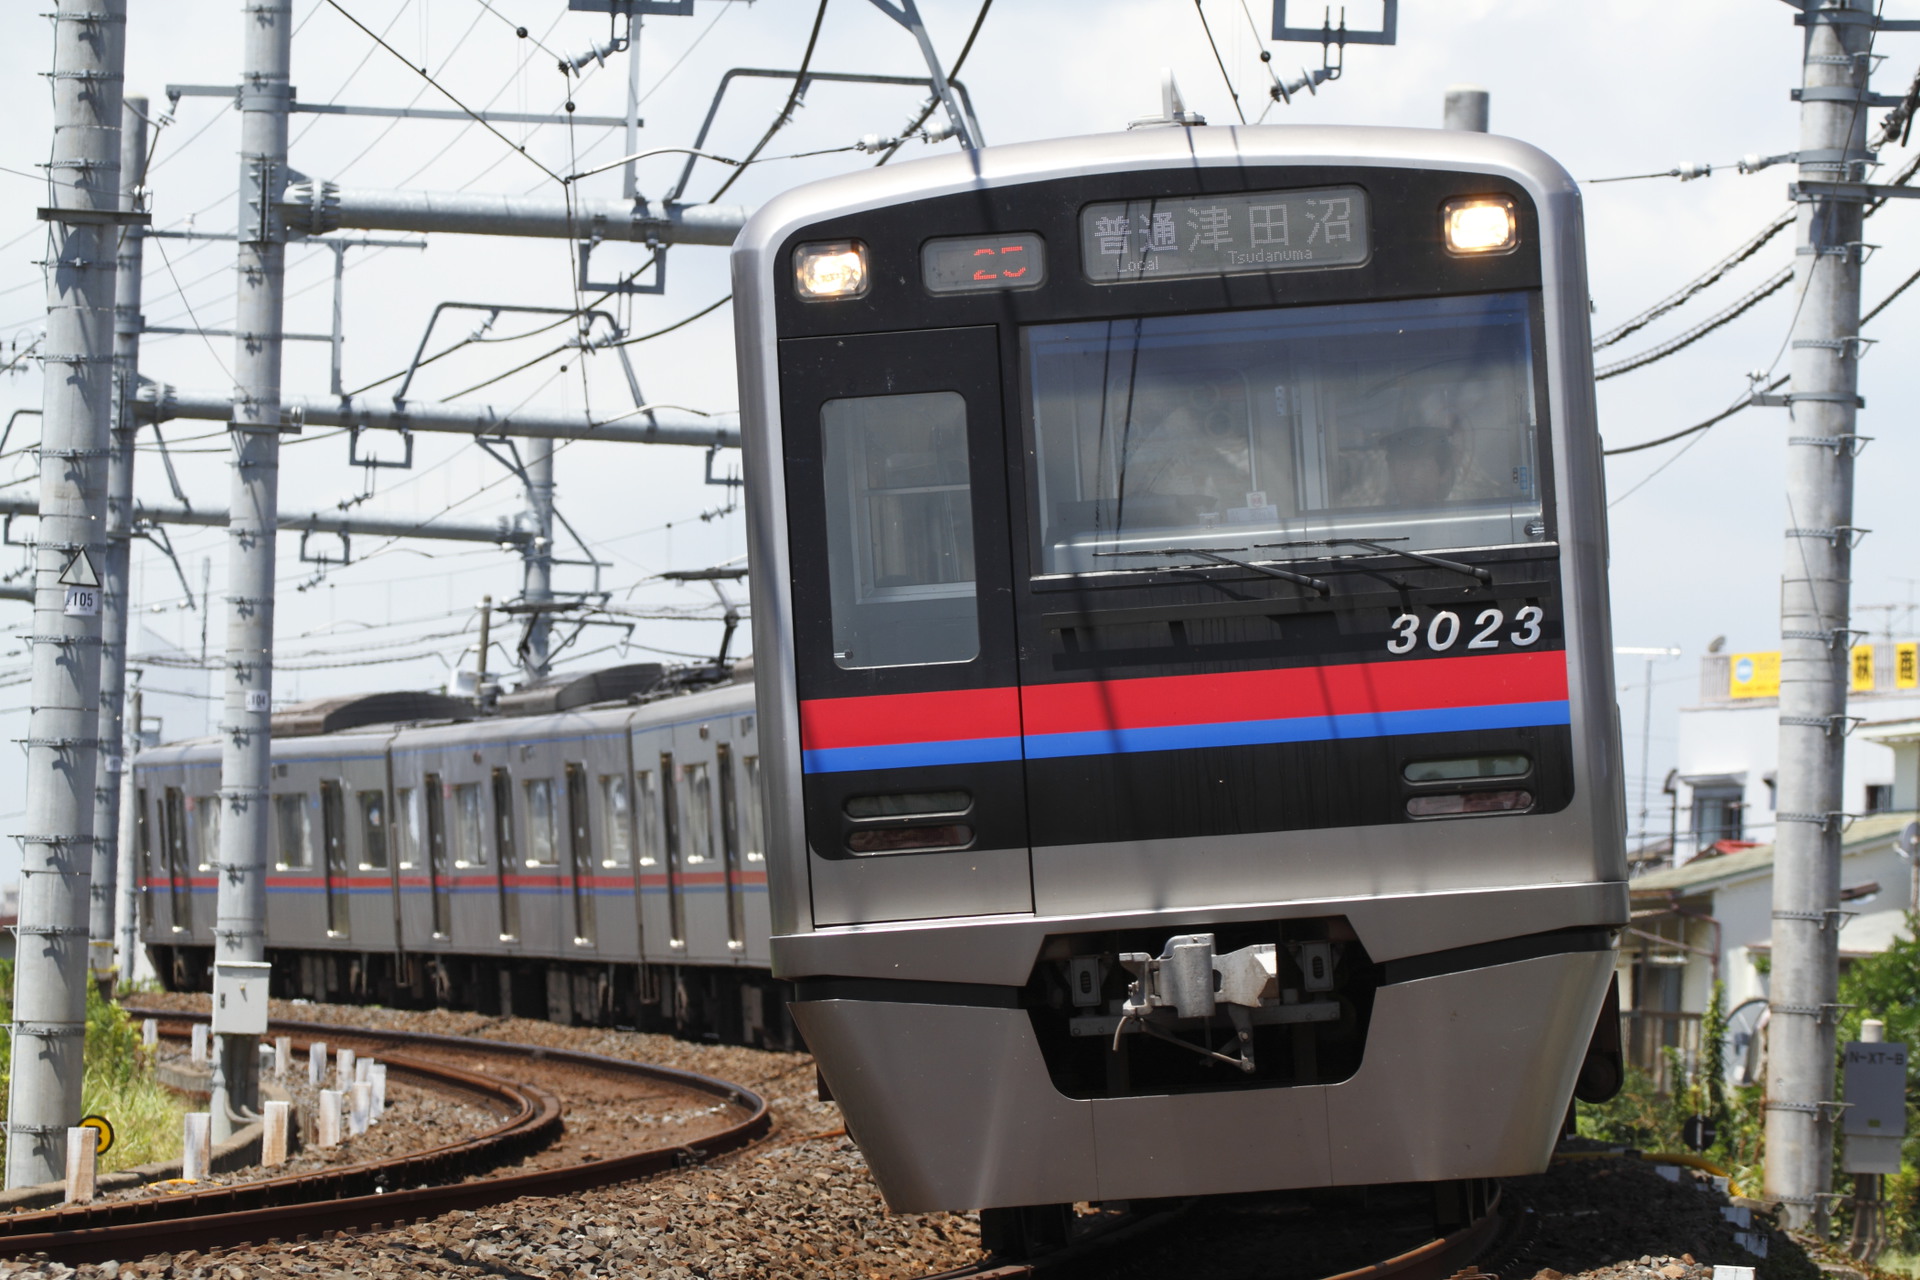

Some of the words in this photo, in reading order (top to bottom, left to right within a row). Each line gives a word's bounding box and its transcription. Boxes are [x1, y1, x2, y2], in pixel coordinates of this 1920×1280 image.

[1095, 211, 1178, 255] 普通
[1187, 198, 1350, 252] 津田沼
[1116, 256, 1159, 273] Local
[1228, 249, 1313, 265] Tsudanuma
[74, 592, 93, 607] 105
[1387, 606, 1543, 654] 3023
